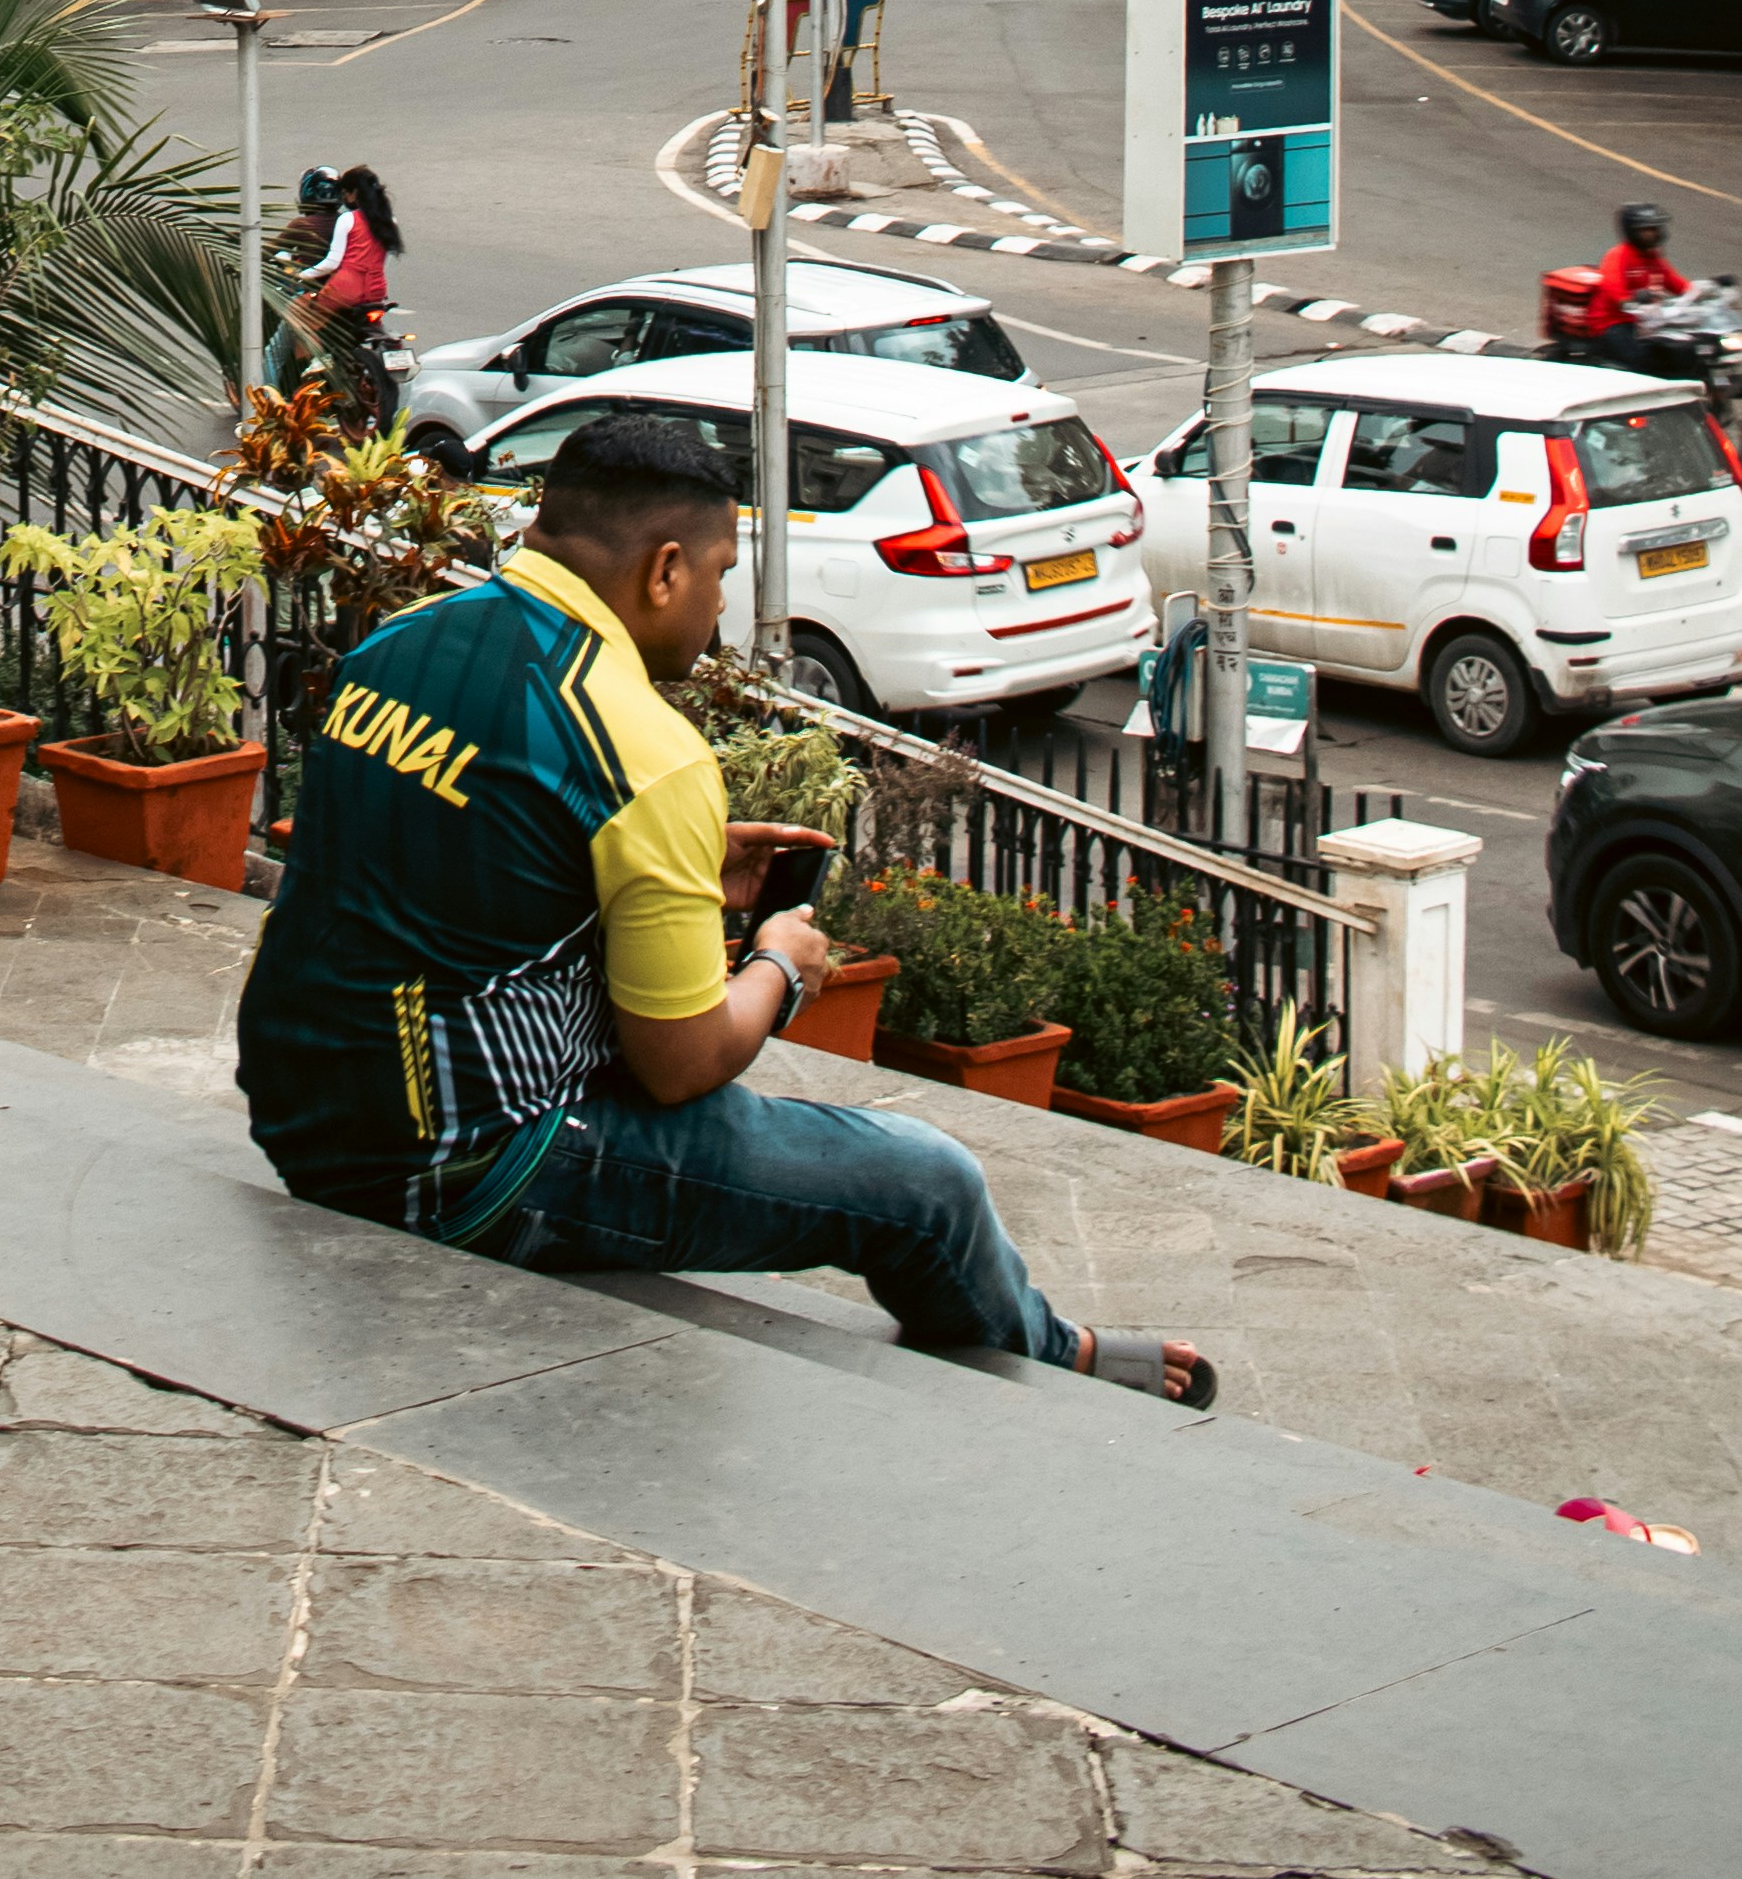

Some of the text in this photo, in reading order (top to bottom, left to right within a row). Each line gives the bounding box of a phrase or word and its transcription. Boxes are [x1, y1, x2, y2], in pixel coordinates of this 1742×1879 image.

[1202, 4, 1250, 21] Bespoke
[1266, 0, 1312, 14] Laundry
[322, 682, 480, 808] KUNAL
